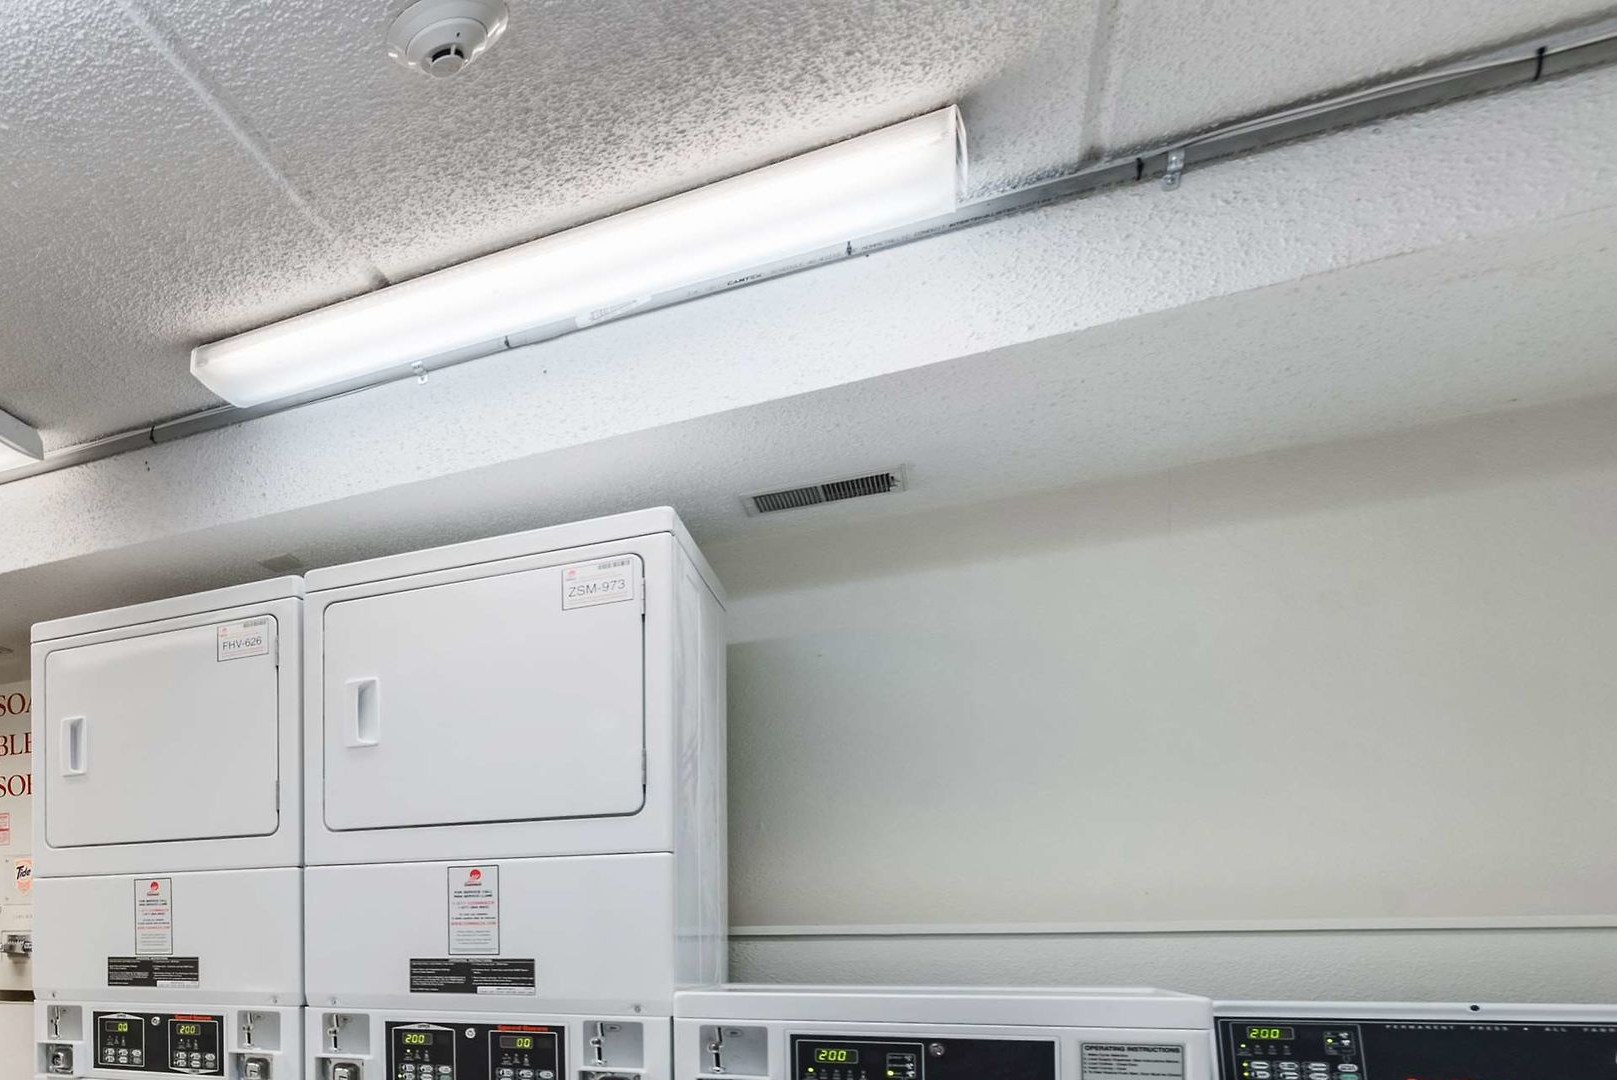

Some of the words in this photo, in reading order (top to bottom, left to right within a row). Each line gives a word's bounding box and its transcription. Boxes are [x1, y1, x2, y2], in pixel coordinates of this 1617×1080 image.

[568, 579, 626, 598] ZSM-973
[16, 865, 32, 880] Tide
[179, 1025, 196, 1034] 200
[1249, 1028, 1280, 1039] 200
[404, 1033, 425, 1043] 200
[818, 1050, 847, 1061] 200
